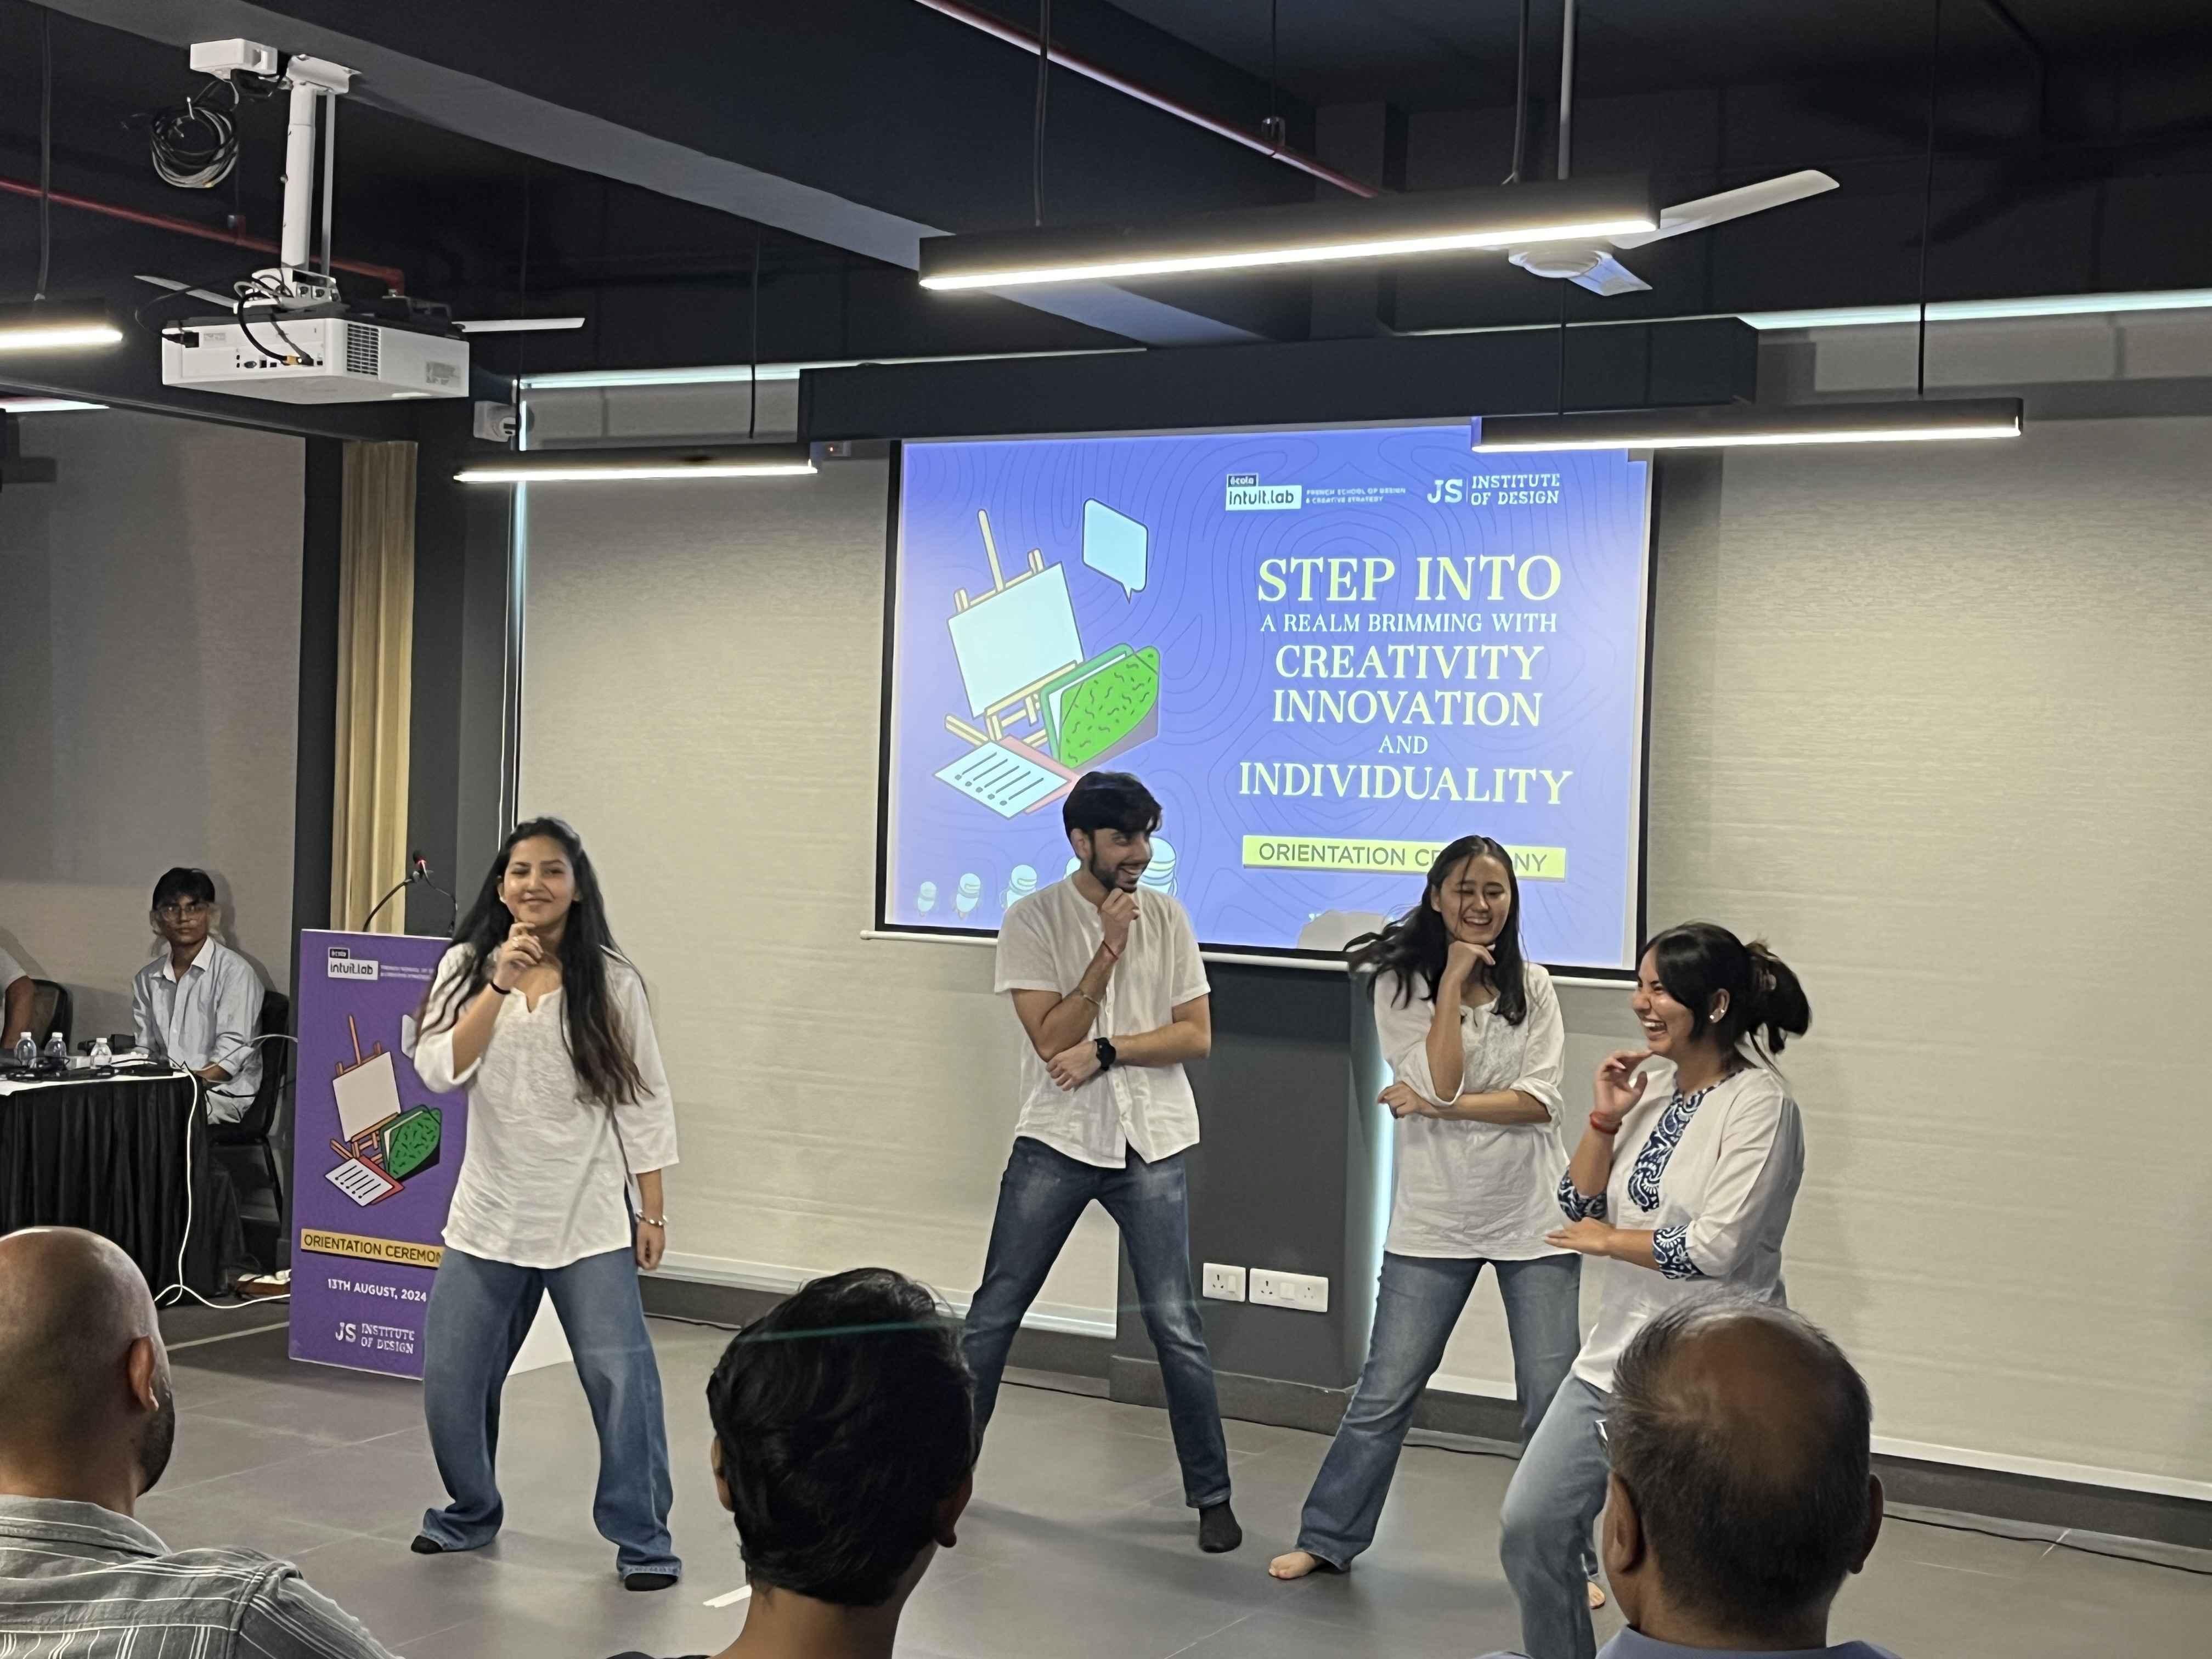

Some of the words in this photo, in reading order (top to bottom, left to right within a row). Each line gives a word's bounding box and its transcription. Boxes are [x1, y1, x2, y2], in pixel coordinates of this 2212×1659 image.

[1427, 479, 1463, 504] JS
[1472, 473, 1560, 489] INSTITUTE
[1229, 490, 1294, 505] intuit.lab
[1471, 492, 1491, 505] OF
[1498, 490, 1559, 505] DESIGN
[1258, 557, 1395, 602] STEP
[1415, 554, 1561, 601] INTO
[1260, 614, 1276, 632] A
[1283, 613, 1360, 632] REALM
[1368, 613, 1482, 632] BRIMMING
[1492, 613, 1556, 633] WITH
[1276, 644, 1544, 680] CREATIVITY
[1273, 690, 1542, 726] INNOVATION
[1378, 735, 1428, 754] AND
[1239, 762, 1573, 804] INDIVIDUALITY
[1259, 842, 1406, 866] ORIENTATION
[303, 1234, 382, 1255] ORIENTATION
[328, 1278, 351, 1291] 13TH
[353, 1282, 398, 1300] AUGUST,
[400, 1289, 427, 1302] 2024
[335, 1322, 357, 1343] JS
[361, 1323, 415, 1341] INSTITUTE
[360, 1336, 374, 1348] OF
[377, 1339, 414, 1355] DESIGN
